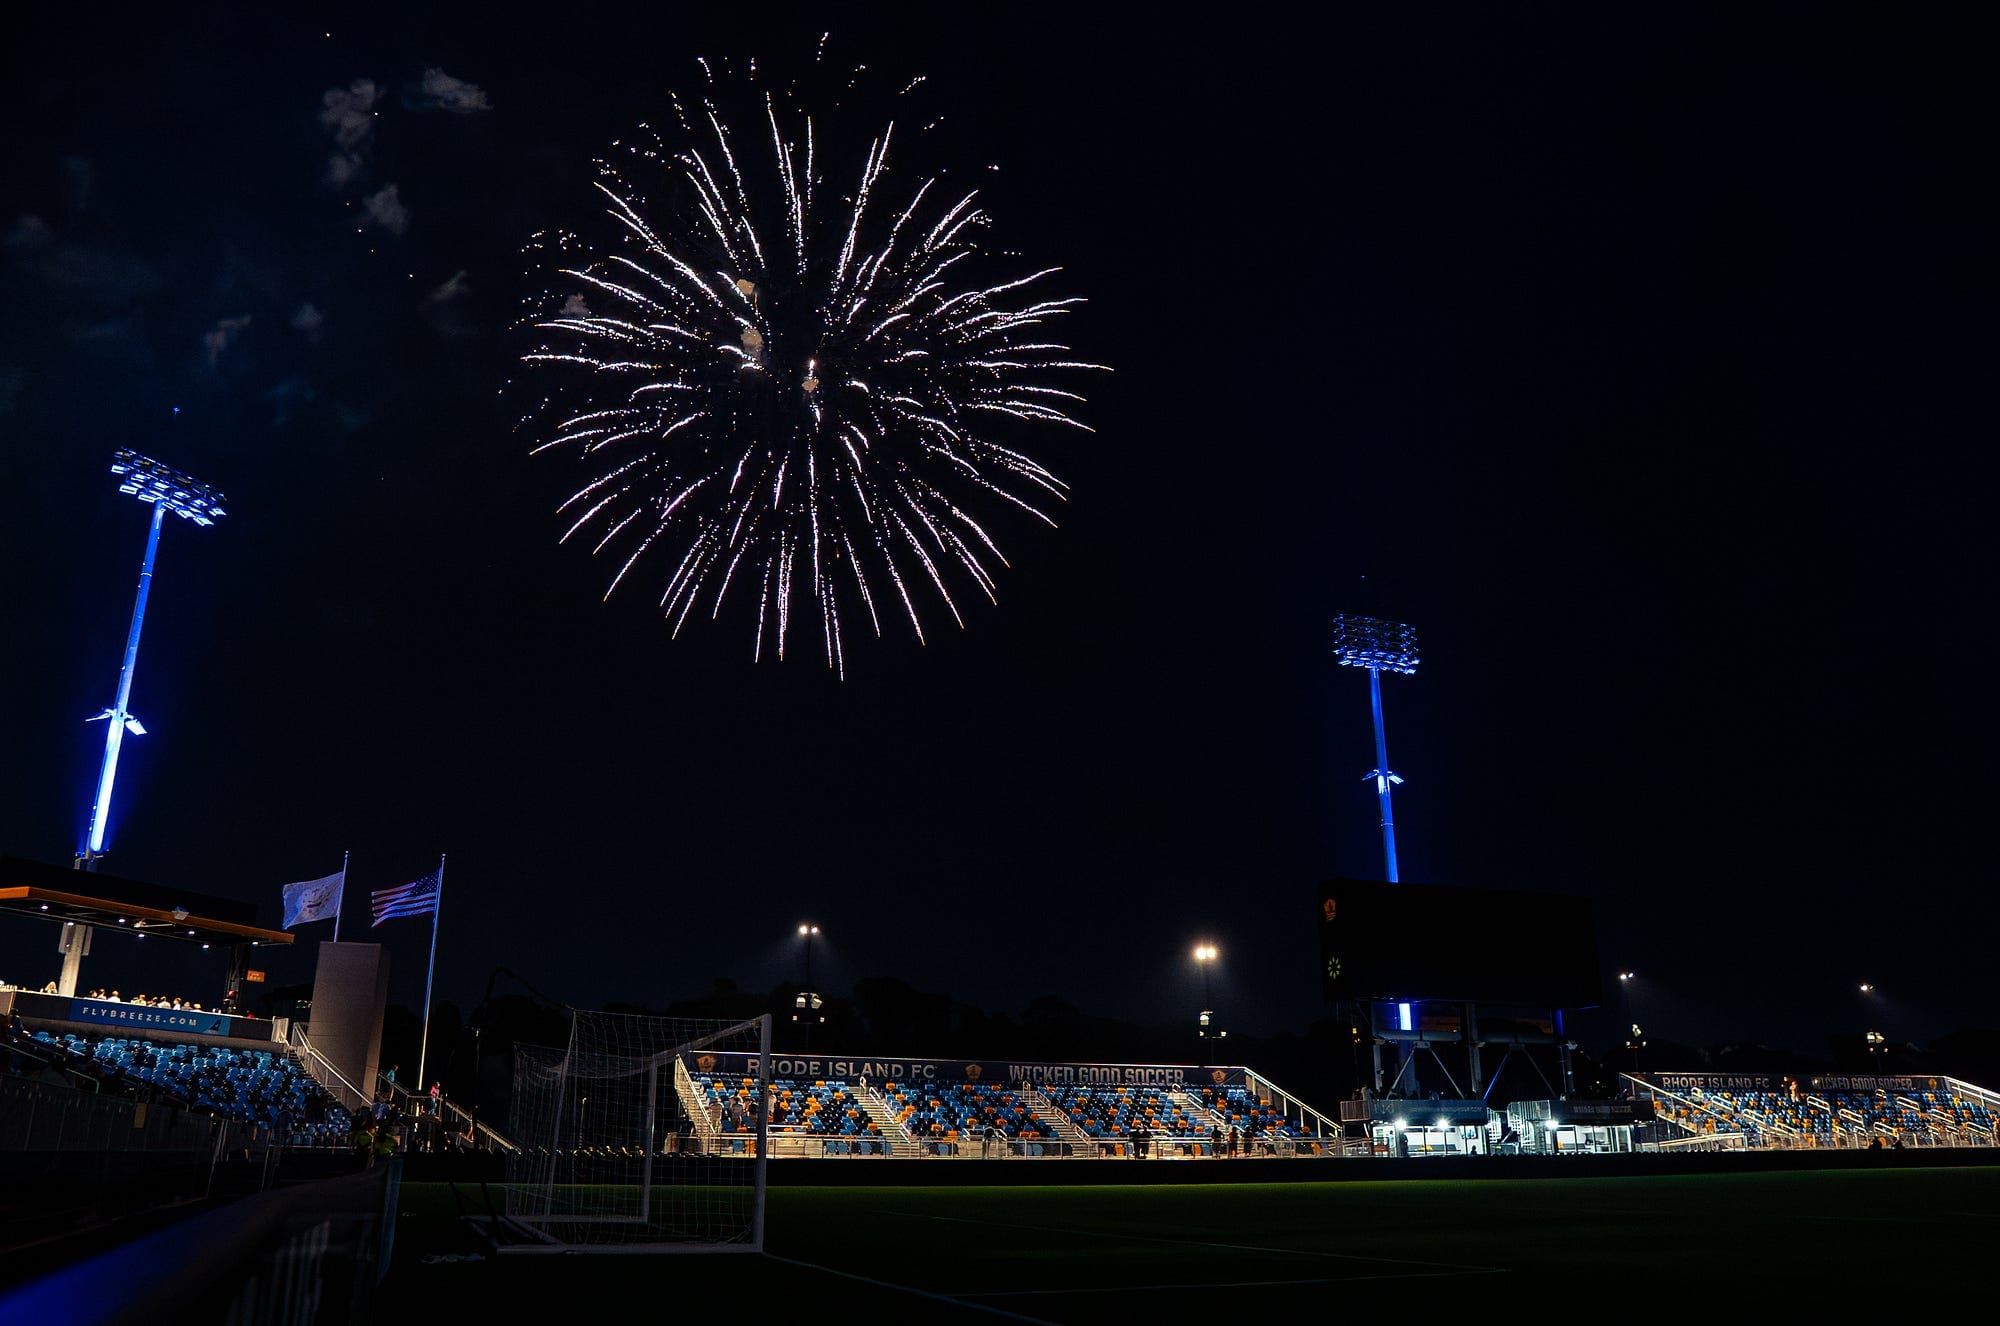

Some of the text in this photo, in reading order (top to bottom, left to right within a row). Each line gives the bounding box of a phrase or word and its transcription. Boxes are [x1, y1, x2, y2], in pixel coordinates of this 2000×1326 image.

[81, 1007, 197, 1027] FLYBREEZE.COM
[828, 1061, 904, 1078] ISLAND
[911, 1064, 936, 1079] FC
[1009, 1065, 1184, 1086] WICKED GOOD SOCCER
[1661, 1076, 1770, 1089] RHODE ISLAND FC
